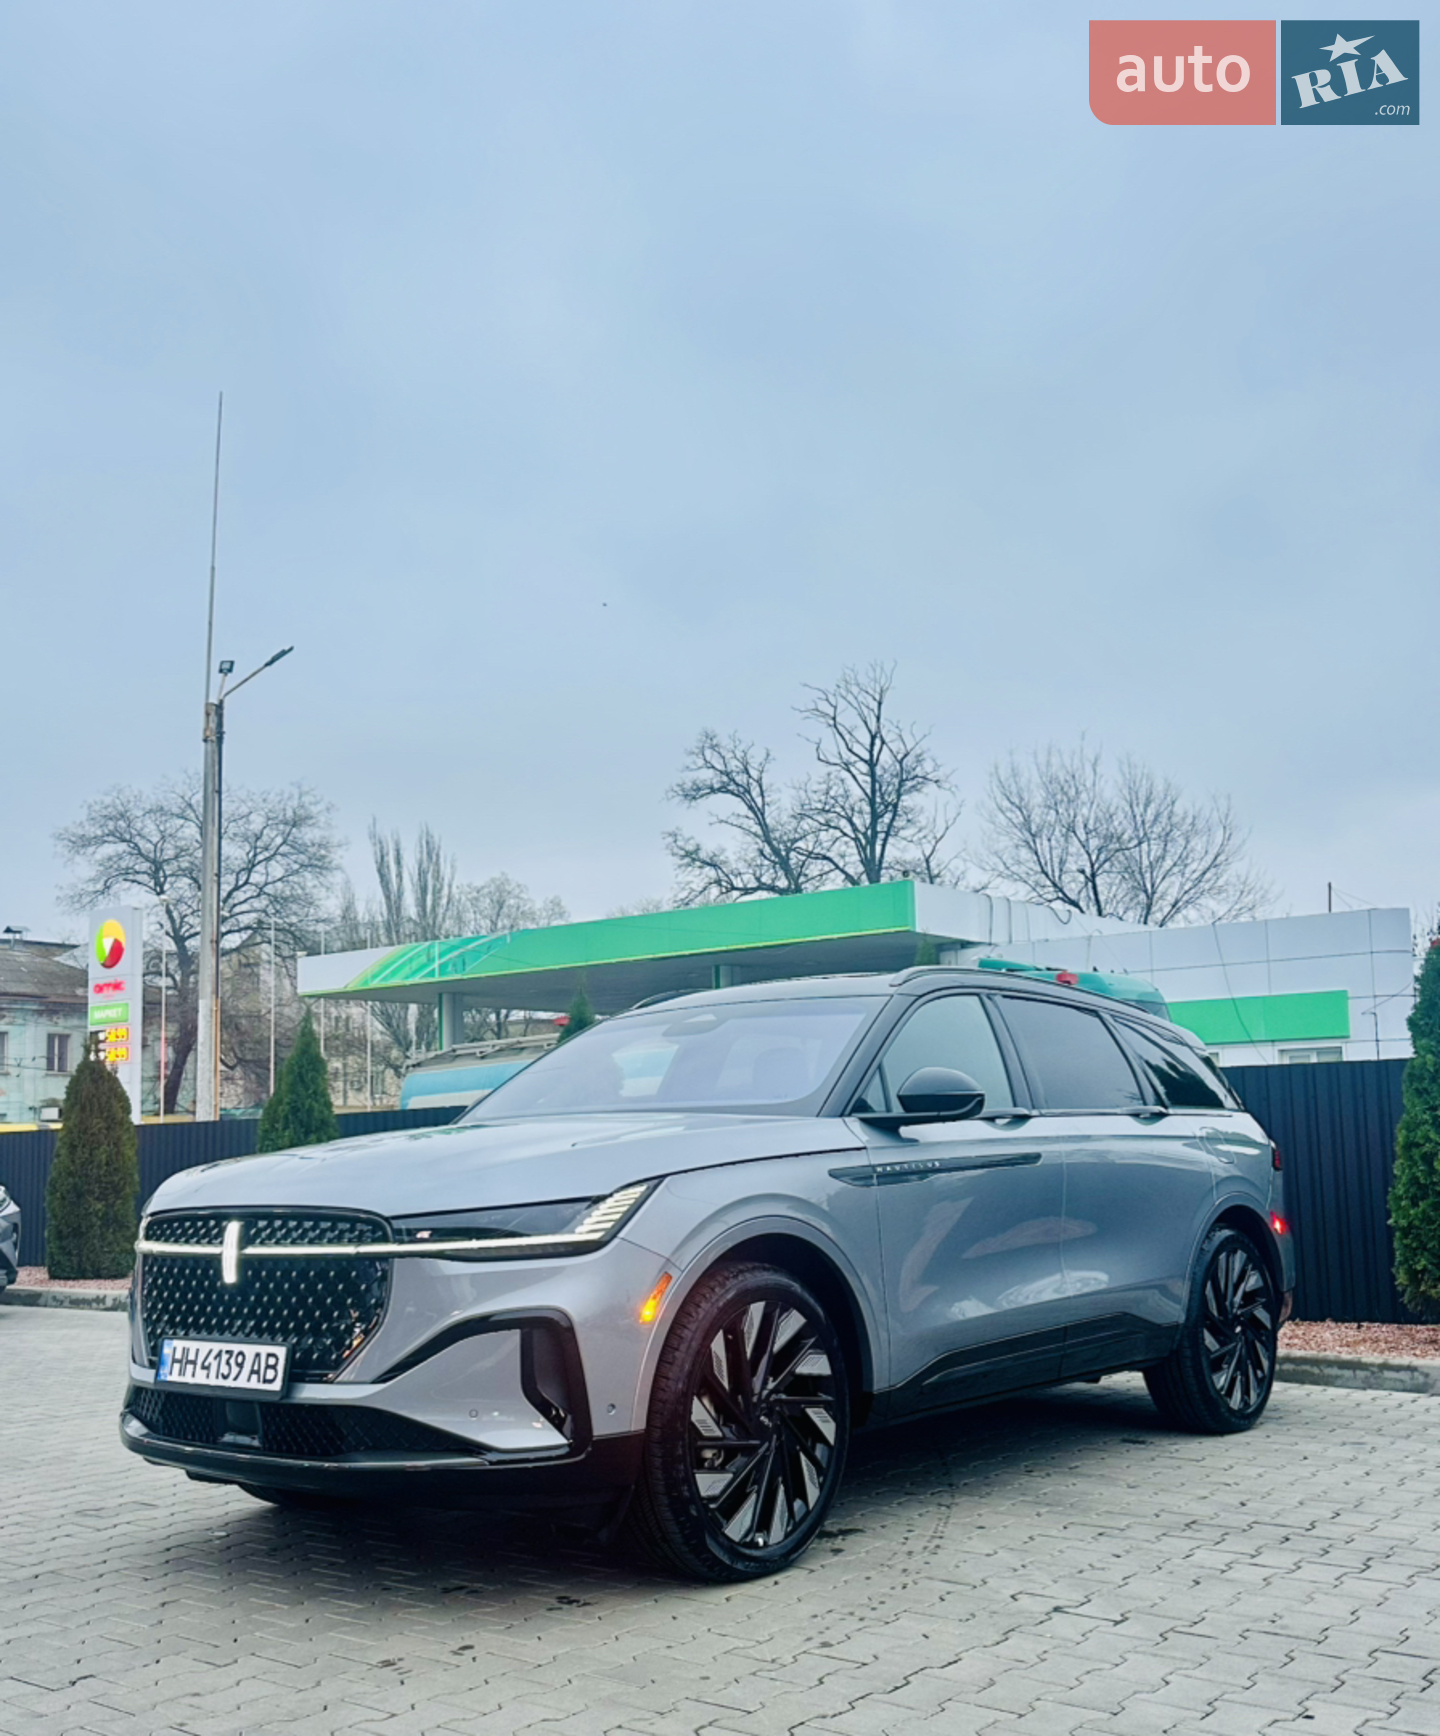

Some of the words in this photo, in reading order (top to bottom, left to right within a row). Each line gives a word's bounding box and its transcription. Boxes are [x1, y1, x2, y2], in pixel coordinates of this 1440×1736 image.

[876, 1161, 941, 1173] NAUTILUS
[169, 1346, 200, 1378] HH
[200, 1348, 246, 1381] 4139
[247, 1352, 279, 1384] AB
